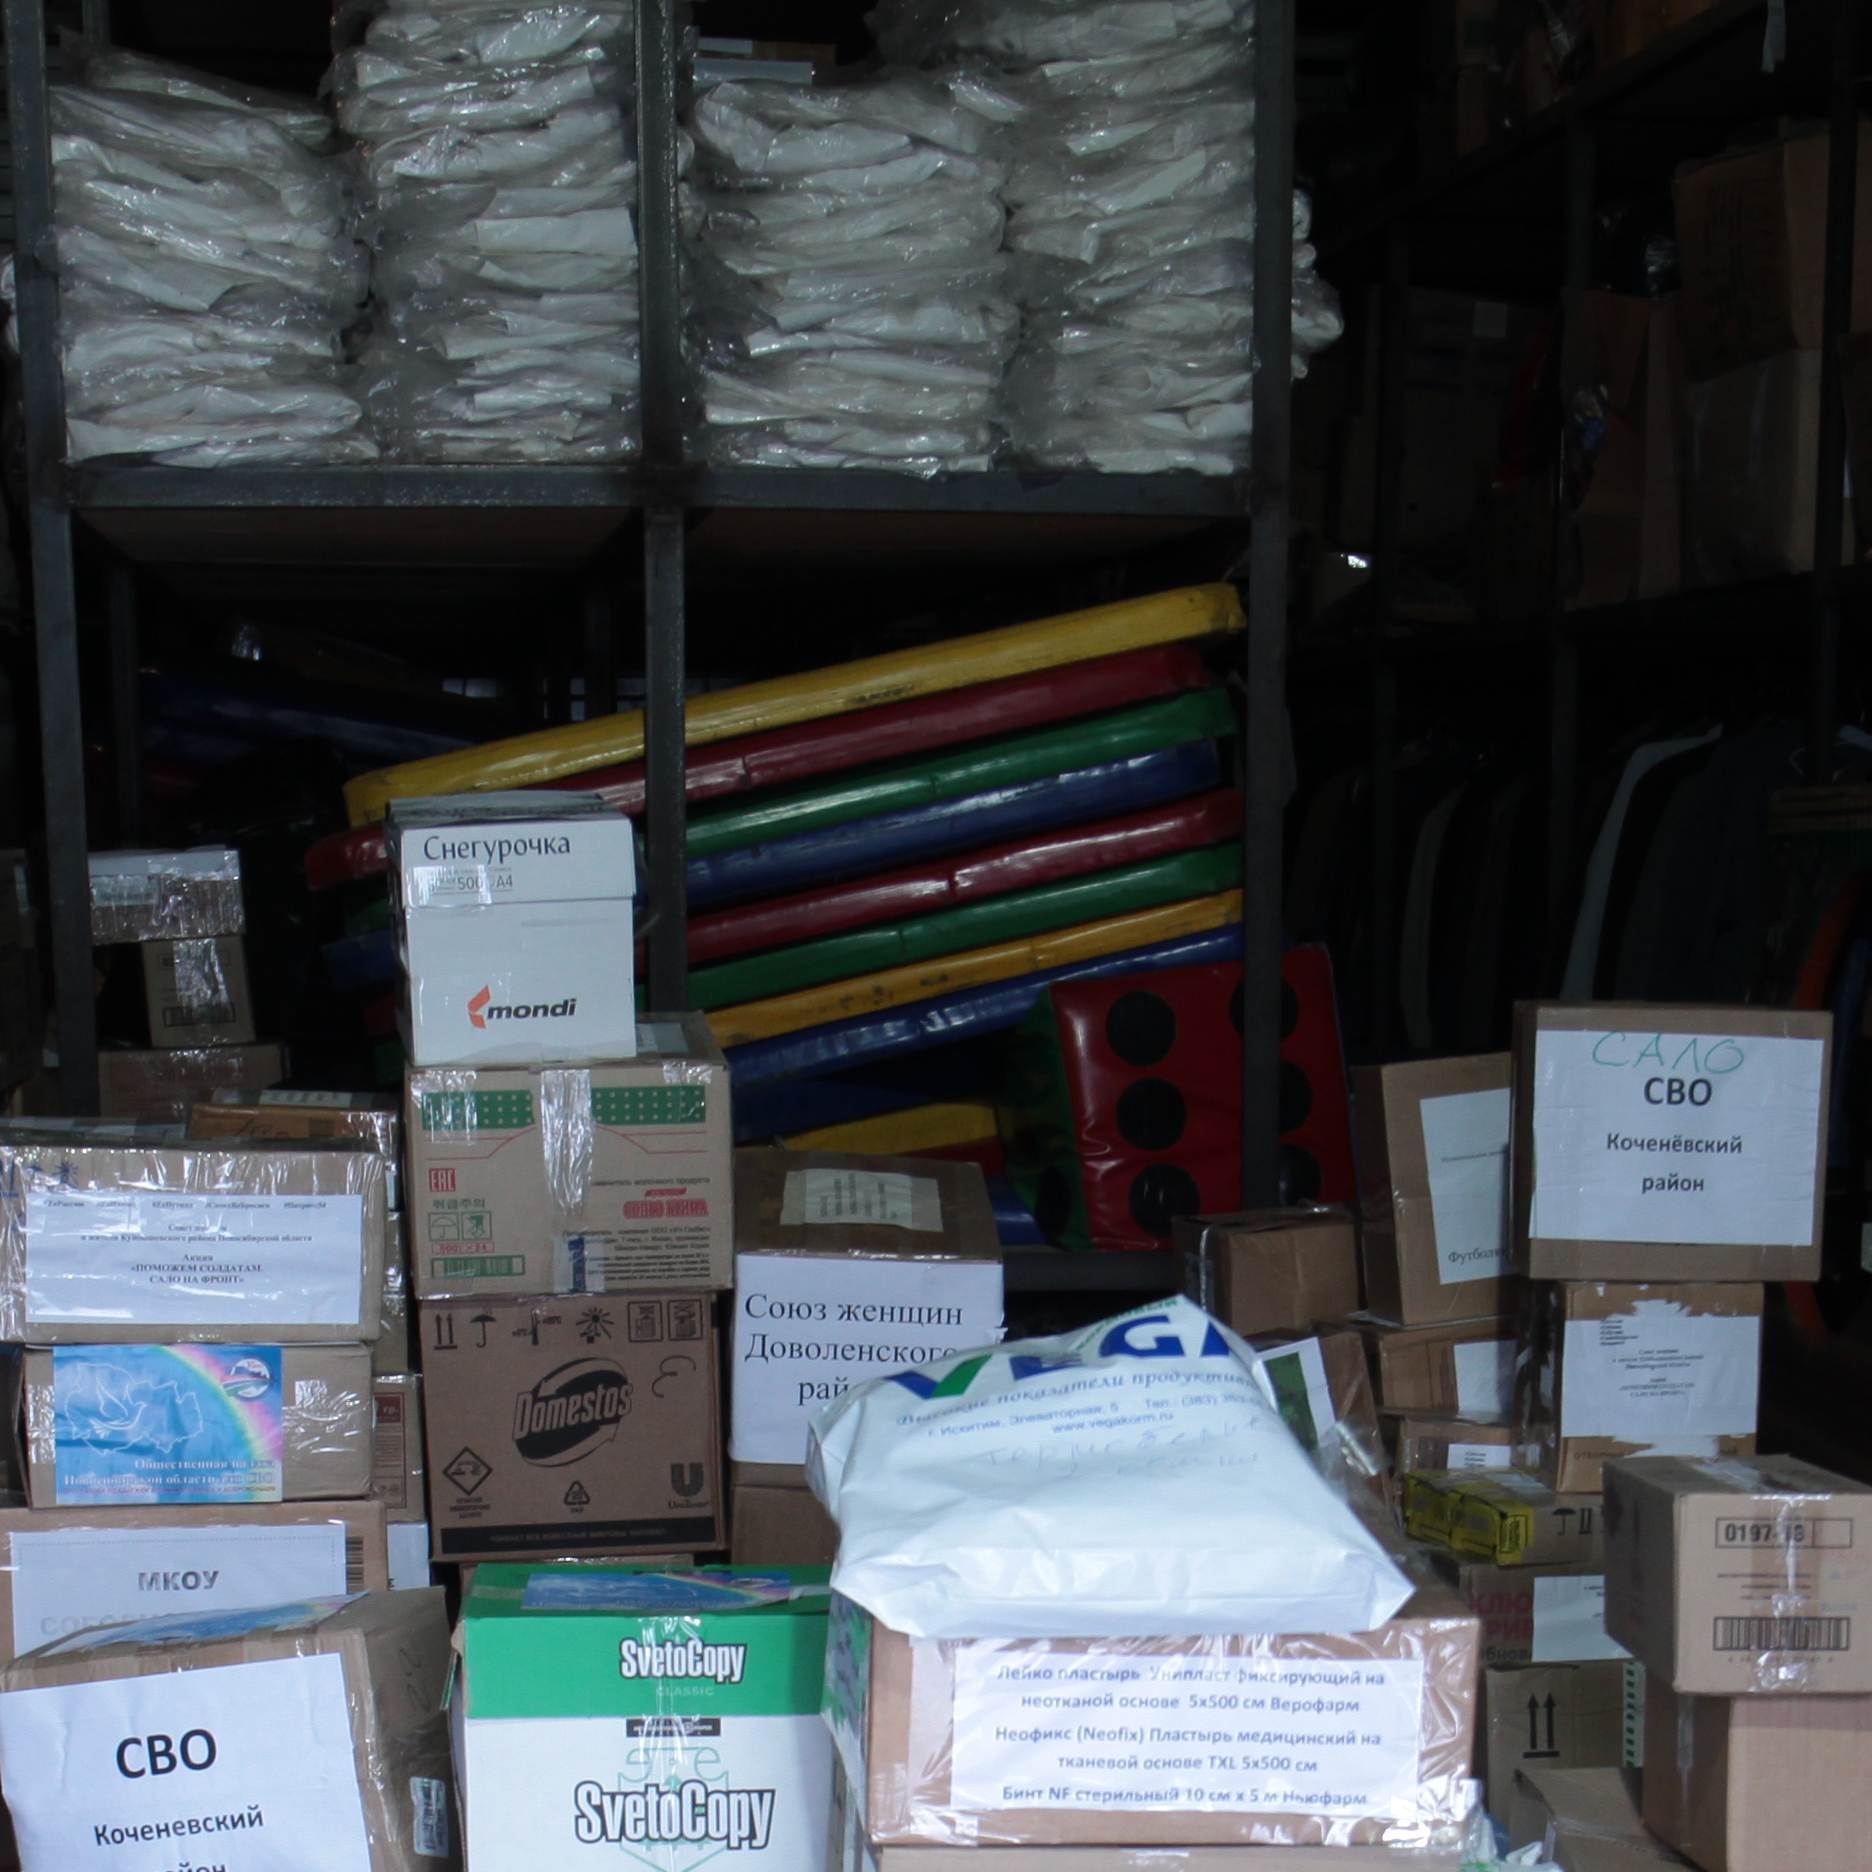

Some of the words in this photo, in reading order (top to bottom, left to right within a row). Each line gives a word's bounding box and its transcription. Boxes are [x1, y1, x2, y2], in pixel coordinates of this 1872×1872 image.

[424, 834, 571, 865] Снегурочка
[496, 874, 513, 889] A4
[487, 998, 577, 1019] mondi
[1592, 1031, 1745, 1074] САЛО
[1643, 1077, 1712, 1108] СВО
[1606, 1131, 1743, 1155] Коченёвский
[1642, 1172, 1705, 1194] район
[131, 1263, 197, 1274] «ПОМОЖЕМ
[149, 1274, 177, 1285] САЛО
[180, 1274, 199, 1284] НА
[745, 1294, 827, 1322] Союз
[837, 1301, 963, 1331] женщин
[798, 1377, 851, 1406] рай
[998, 1373, 1125, 1405] показатели
[517, 1376, 633, 1440] Domestos
[1050, 1410, 1175, 1434] www.vegakorm.ru
[134, 1458, 228, 1471] Общественная
[137, 1569, 220, 1591] МКОУ
[619, 1638, 748, 1685] SvetoCopy
[1058, 1666, 1141, 1683] пластырь
[1236, 1667, 1361, 1688] фиксирующий
[1365, 1673, 1385, 1686] на
[656, 1685, 715, 1697] CLASSIC
[1021, 1694, 1114, 1709] неотканой
[1118, 1696, 1180, 1709] основе
[1243, 1698, 1265, 1710] см
[1270, 1696, 1360, 1714] Верофарм
[995, 1726, 1072, 1744] Неофикс
[1076, 1726, 1145, 1745] (Neofix)
[1149, 1727, 1232, 1746] Пластырь
[1236, 1729, 1357, 1747] медицинский
[1361, 1733, 1381, 1746] на
[115, 1728, 218, 1780] СВО
[1056, 1756, 1139, 1770] тканевой
[1142, 1757, 1202, 1770] основе
[1295, 1759, 1318, 1773] см
[1002, 1786, 1043, 1801] Бинт
[1047, 1787, 1071, 1801] NF
[1075, 1787, 1179, 1803] стерильный
[1185, 1788, 1205, 1801] 10
[1208, 1790, 1230, 1802] см
[1249, 1788, 1259, 1802] 5
[1283, 1789, 1367, 1806] Ньюфарм
[92, 1804, 266, 1847] Коченевский
[573, 1778, 777, 1851] SvetoCopy
